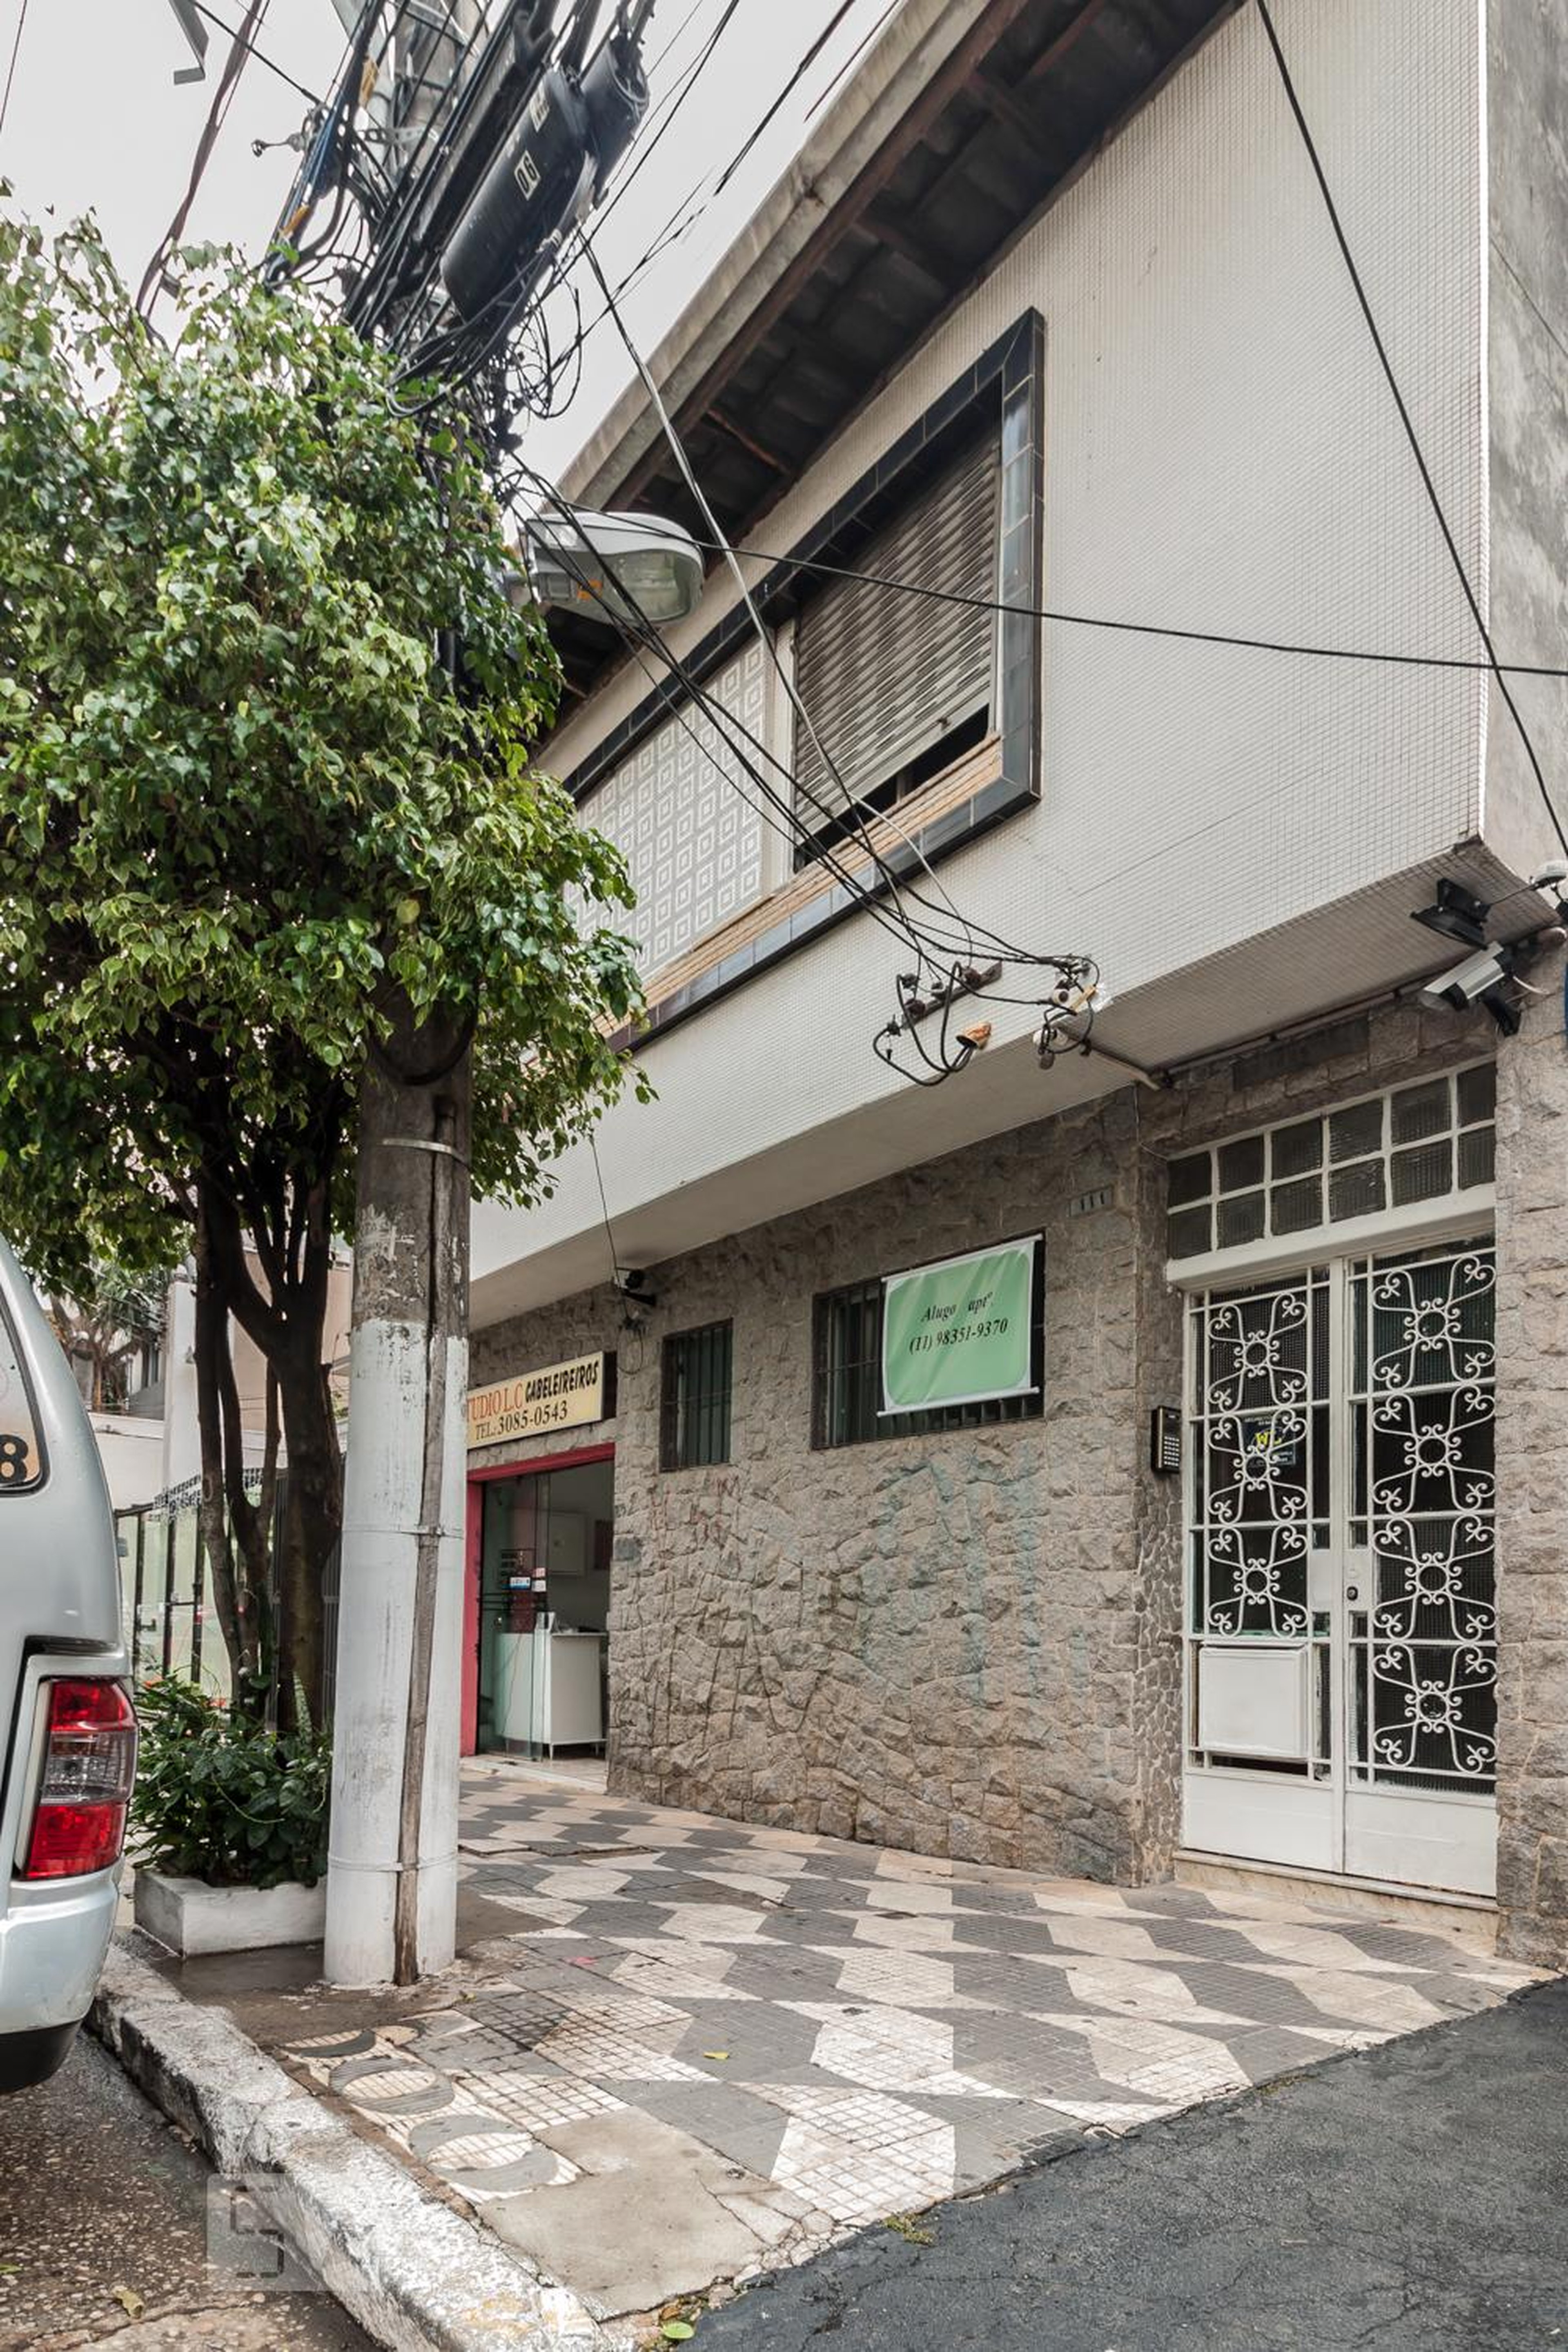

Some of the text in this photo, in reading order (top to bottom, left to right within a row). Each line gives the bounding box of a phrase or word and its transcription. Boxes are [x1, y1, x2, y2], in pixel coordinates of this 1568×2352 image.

[920, 1304, 957, 1323] Alugo
[909, 1317, 1009, 1355] (11) 98351-9370
[467, 1389, 501, 1422] TUDIO
[525, 1360, 599, 1403] CABELEIREIROS
